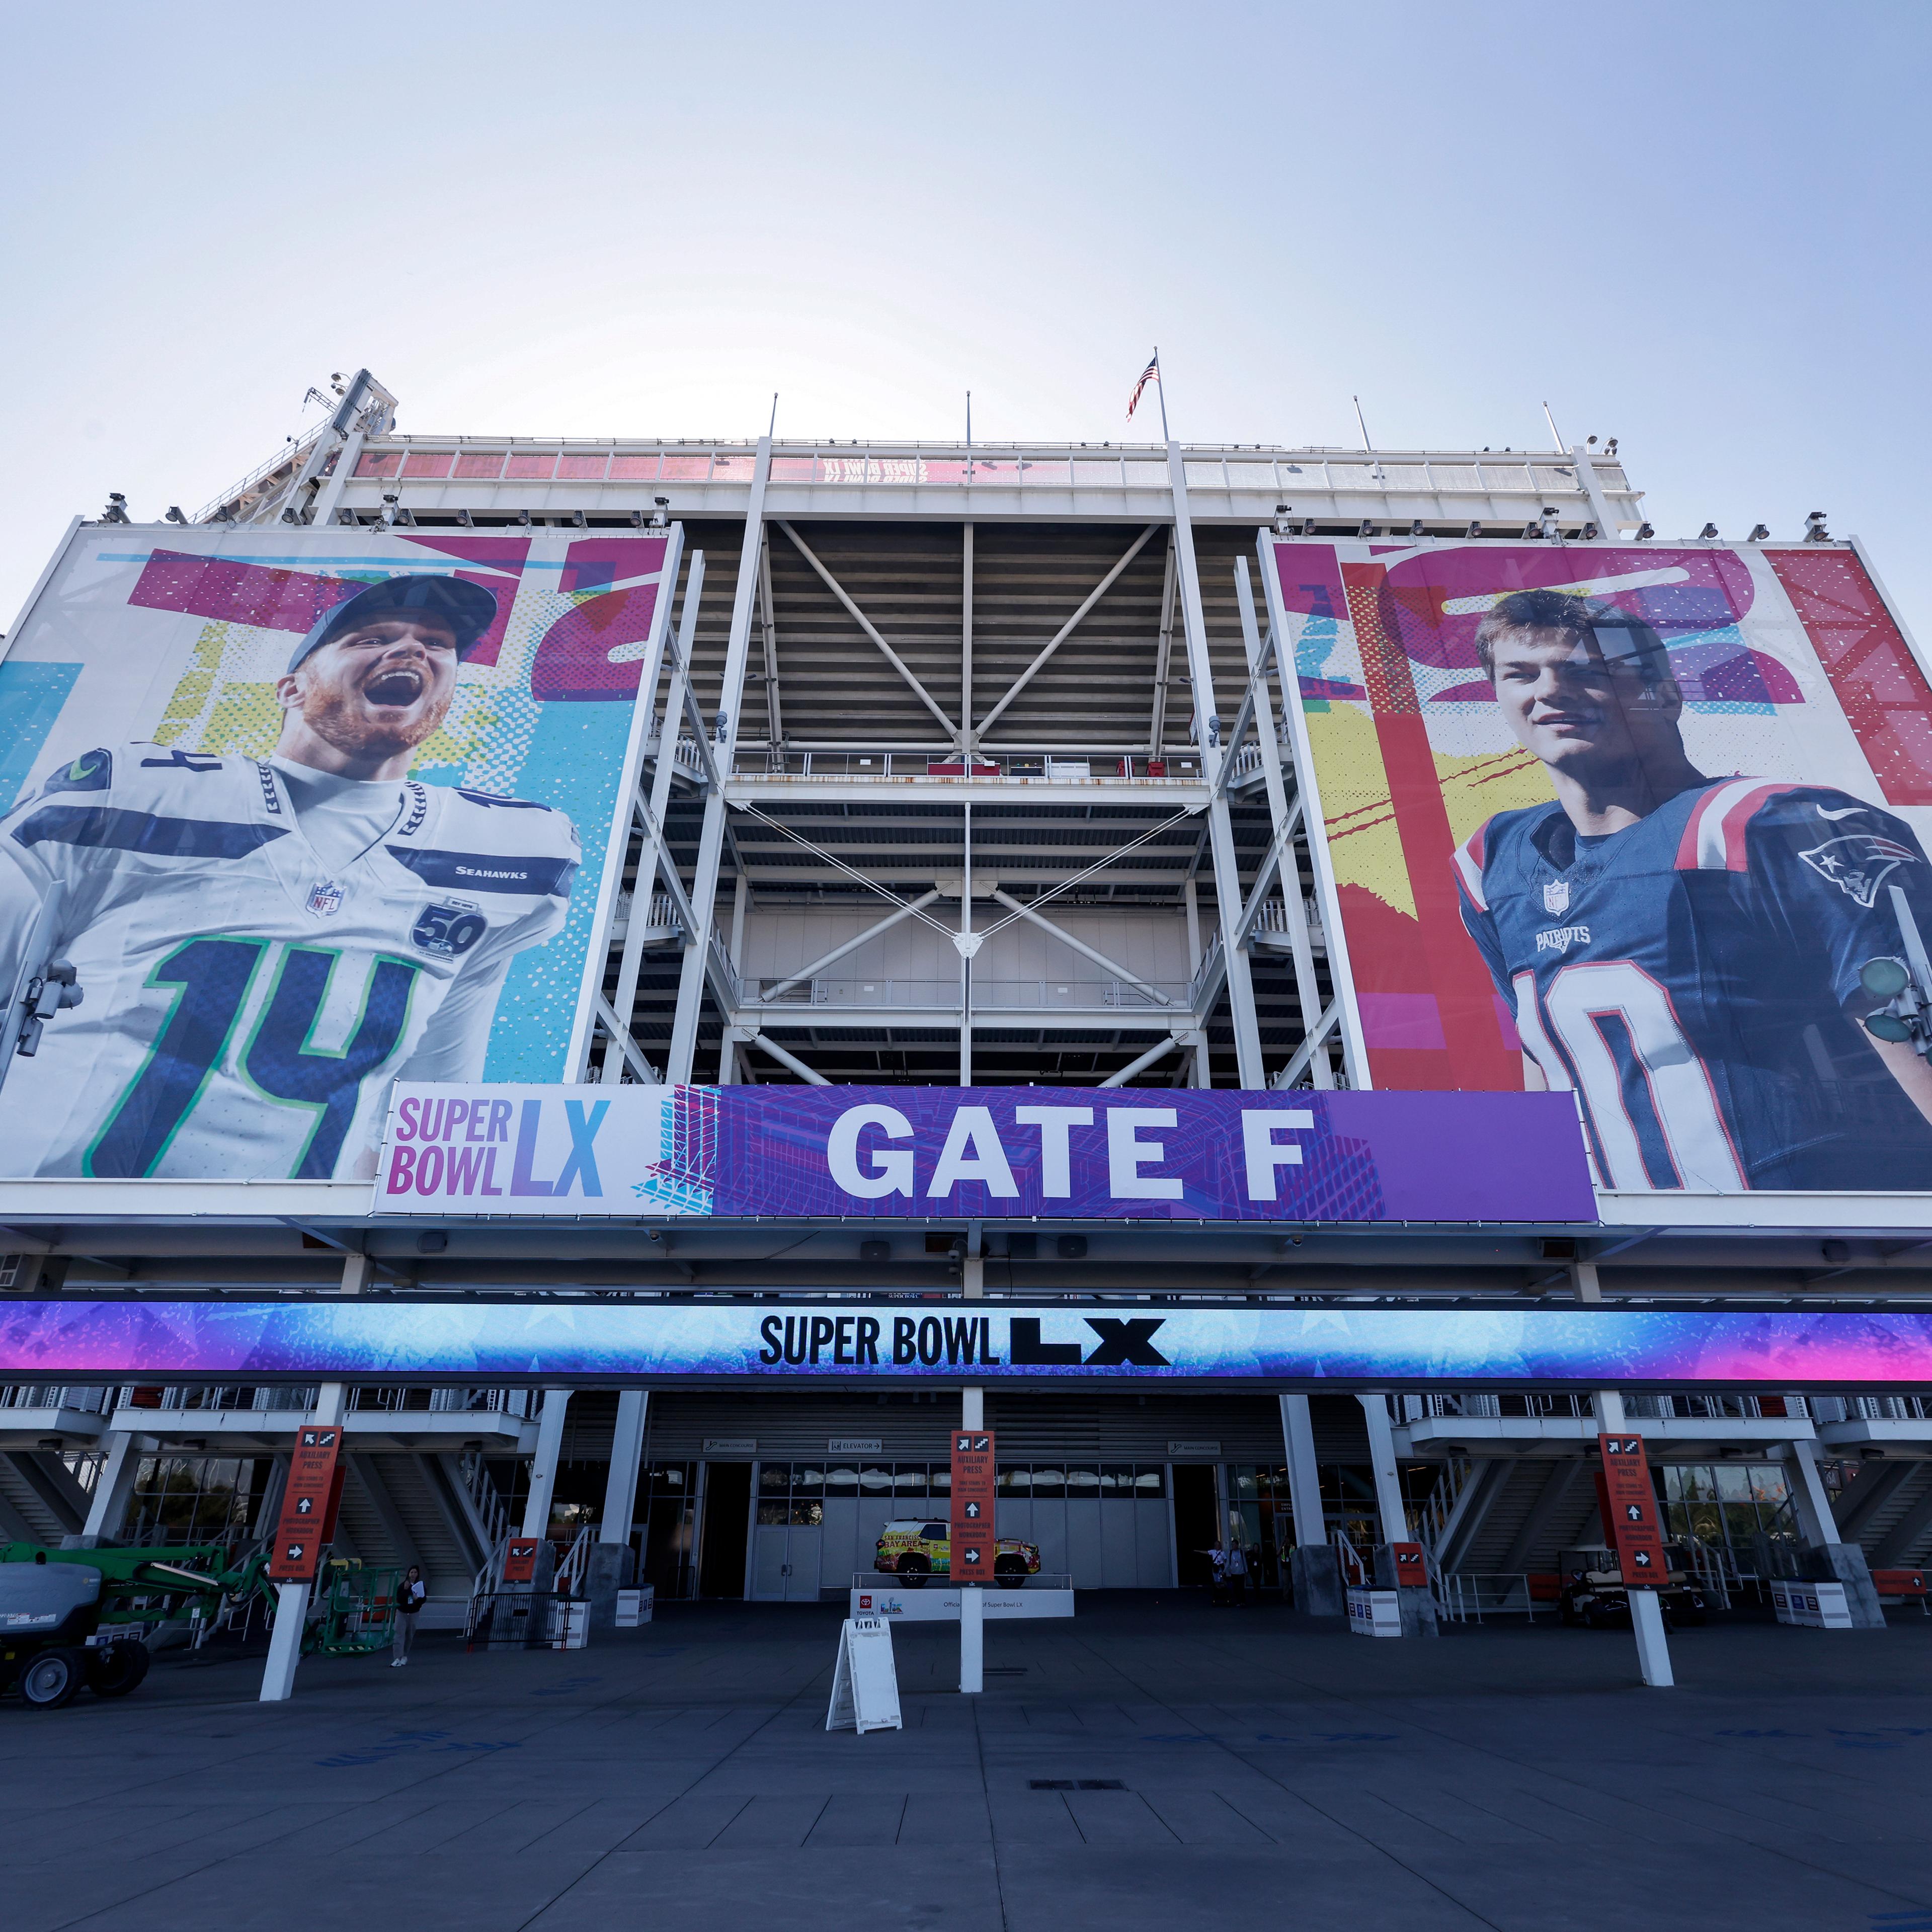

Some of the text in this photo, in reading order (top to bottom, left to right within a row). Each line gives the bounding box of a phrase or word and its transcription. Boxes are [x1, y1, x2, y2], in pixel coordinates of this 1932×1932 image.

[455, 866, 528, 879] SEAHAWKS
[313, 896, 335, 910] NFL
[413, 904, 487, 955] 50
[1536, 926, 1591, 953] PATRIOTS
[82, 934, 425, 1179] 14
[396, 1097, 512, 1142] SUPER
[386, 1145, 504, 1196] BOWL
[510, 1099, 612, 1197] LX
[827, 1103, 1314, 1201] GATE F
[759, 1315, 1171, 1365] SUPER BOWL LX
[299, 1451, 331, 1459] AUXILIARY
[303, 1461, 323, 1469] PRESS
[957, 1456, 988, 1464] AUXILIARY
